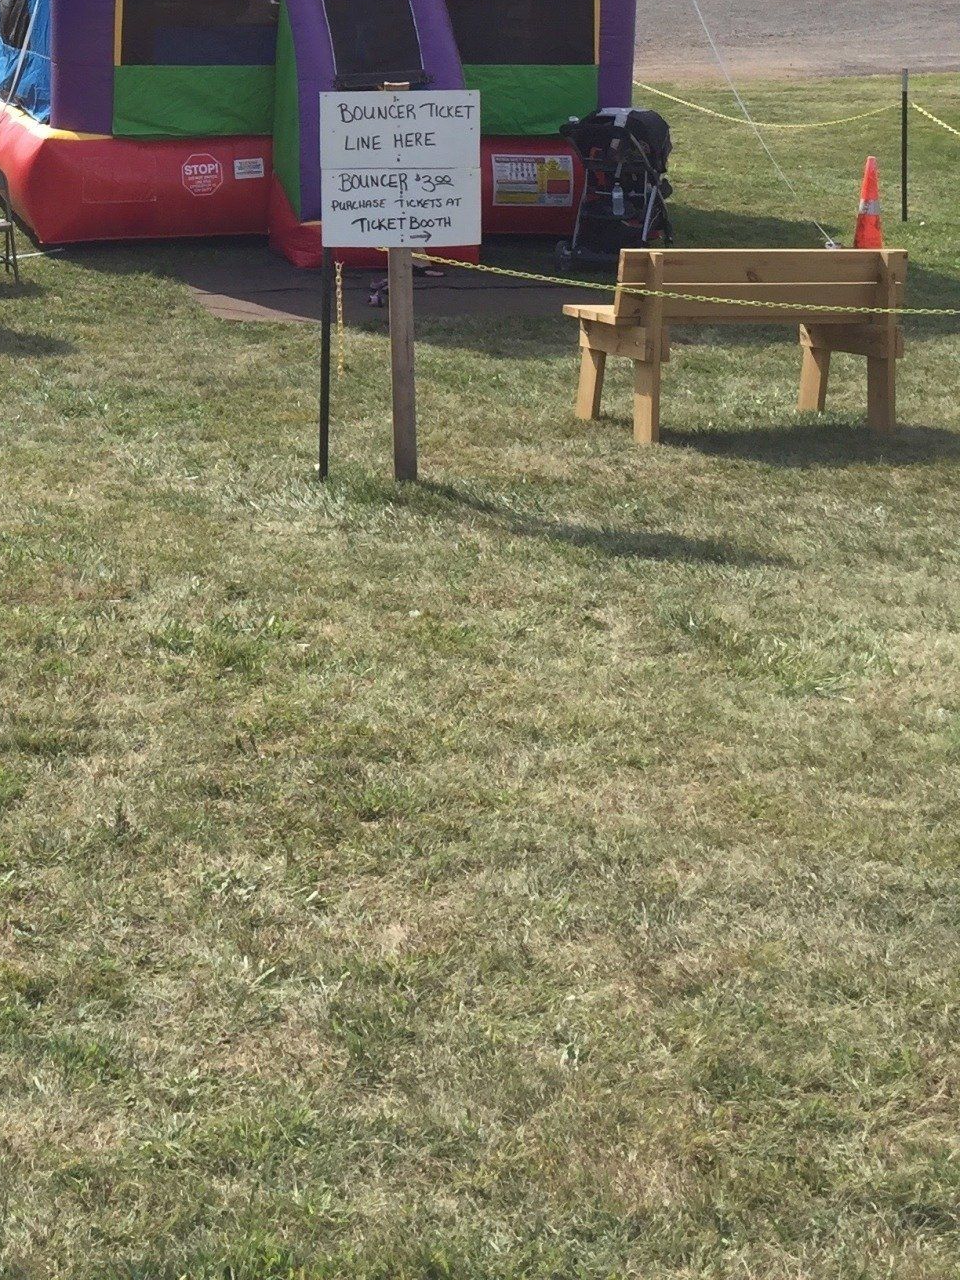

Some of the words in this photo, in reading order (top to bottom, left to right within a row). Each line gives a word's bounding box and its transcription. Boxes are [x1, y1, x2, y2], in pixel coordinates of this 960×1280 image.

[337, 103, 416, 123] BOUNCER
[420, 103, 475, 119] TICKET
[344, 135, 382, 151] LINE
[393, 132, 436, 148] HERE
[184, 163, 218, 175] STOP!
[338, 172, 408, 192] BOUNCER
[330, 199, 387, 211] PURCHASE
[394, 197, 442, 209] TICKETS
[445, 197, 462, 207] AT
[351, 217, 406, 232] TICKET
[409, 216, 452, 230] BOOTH
